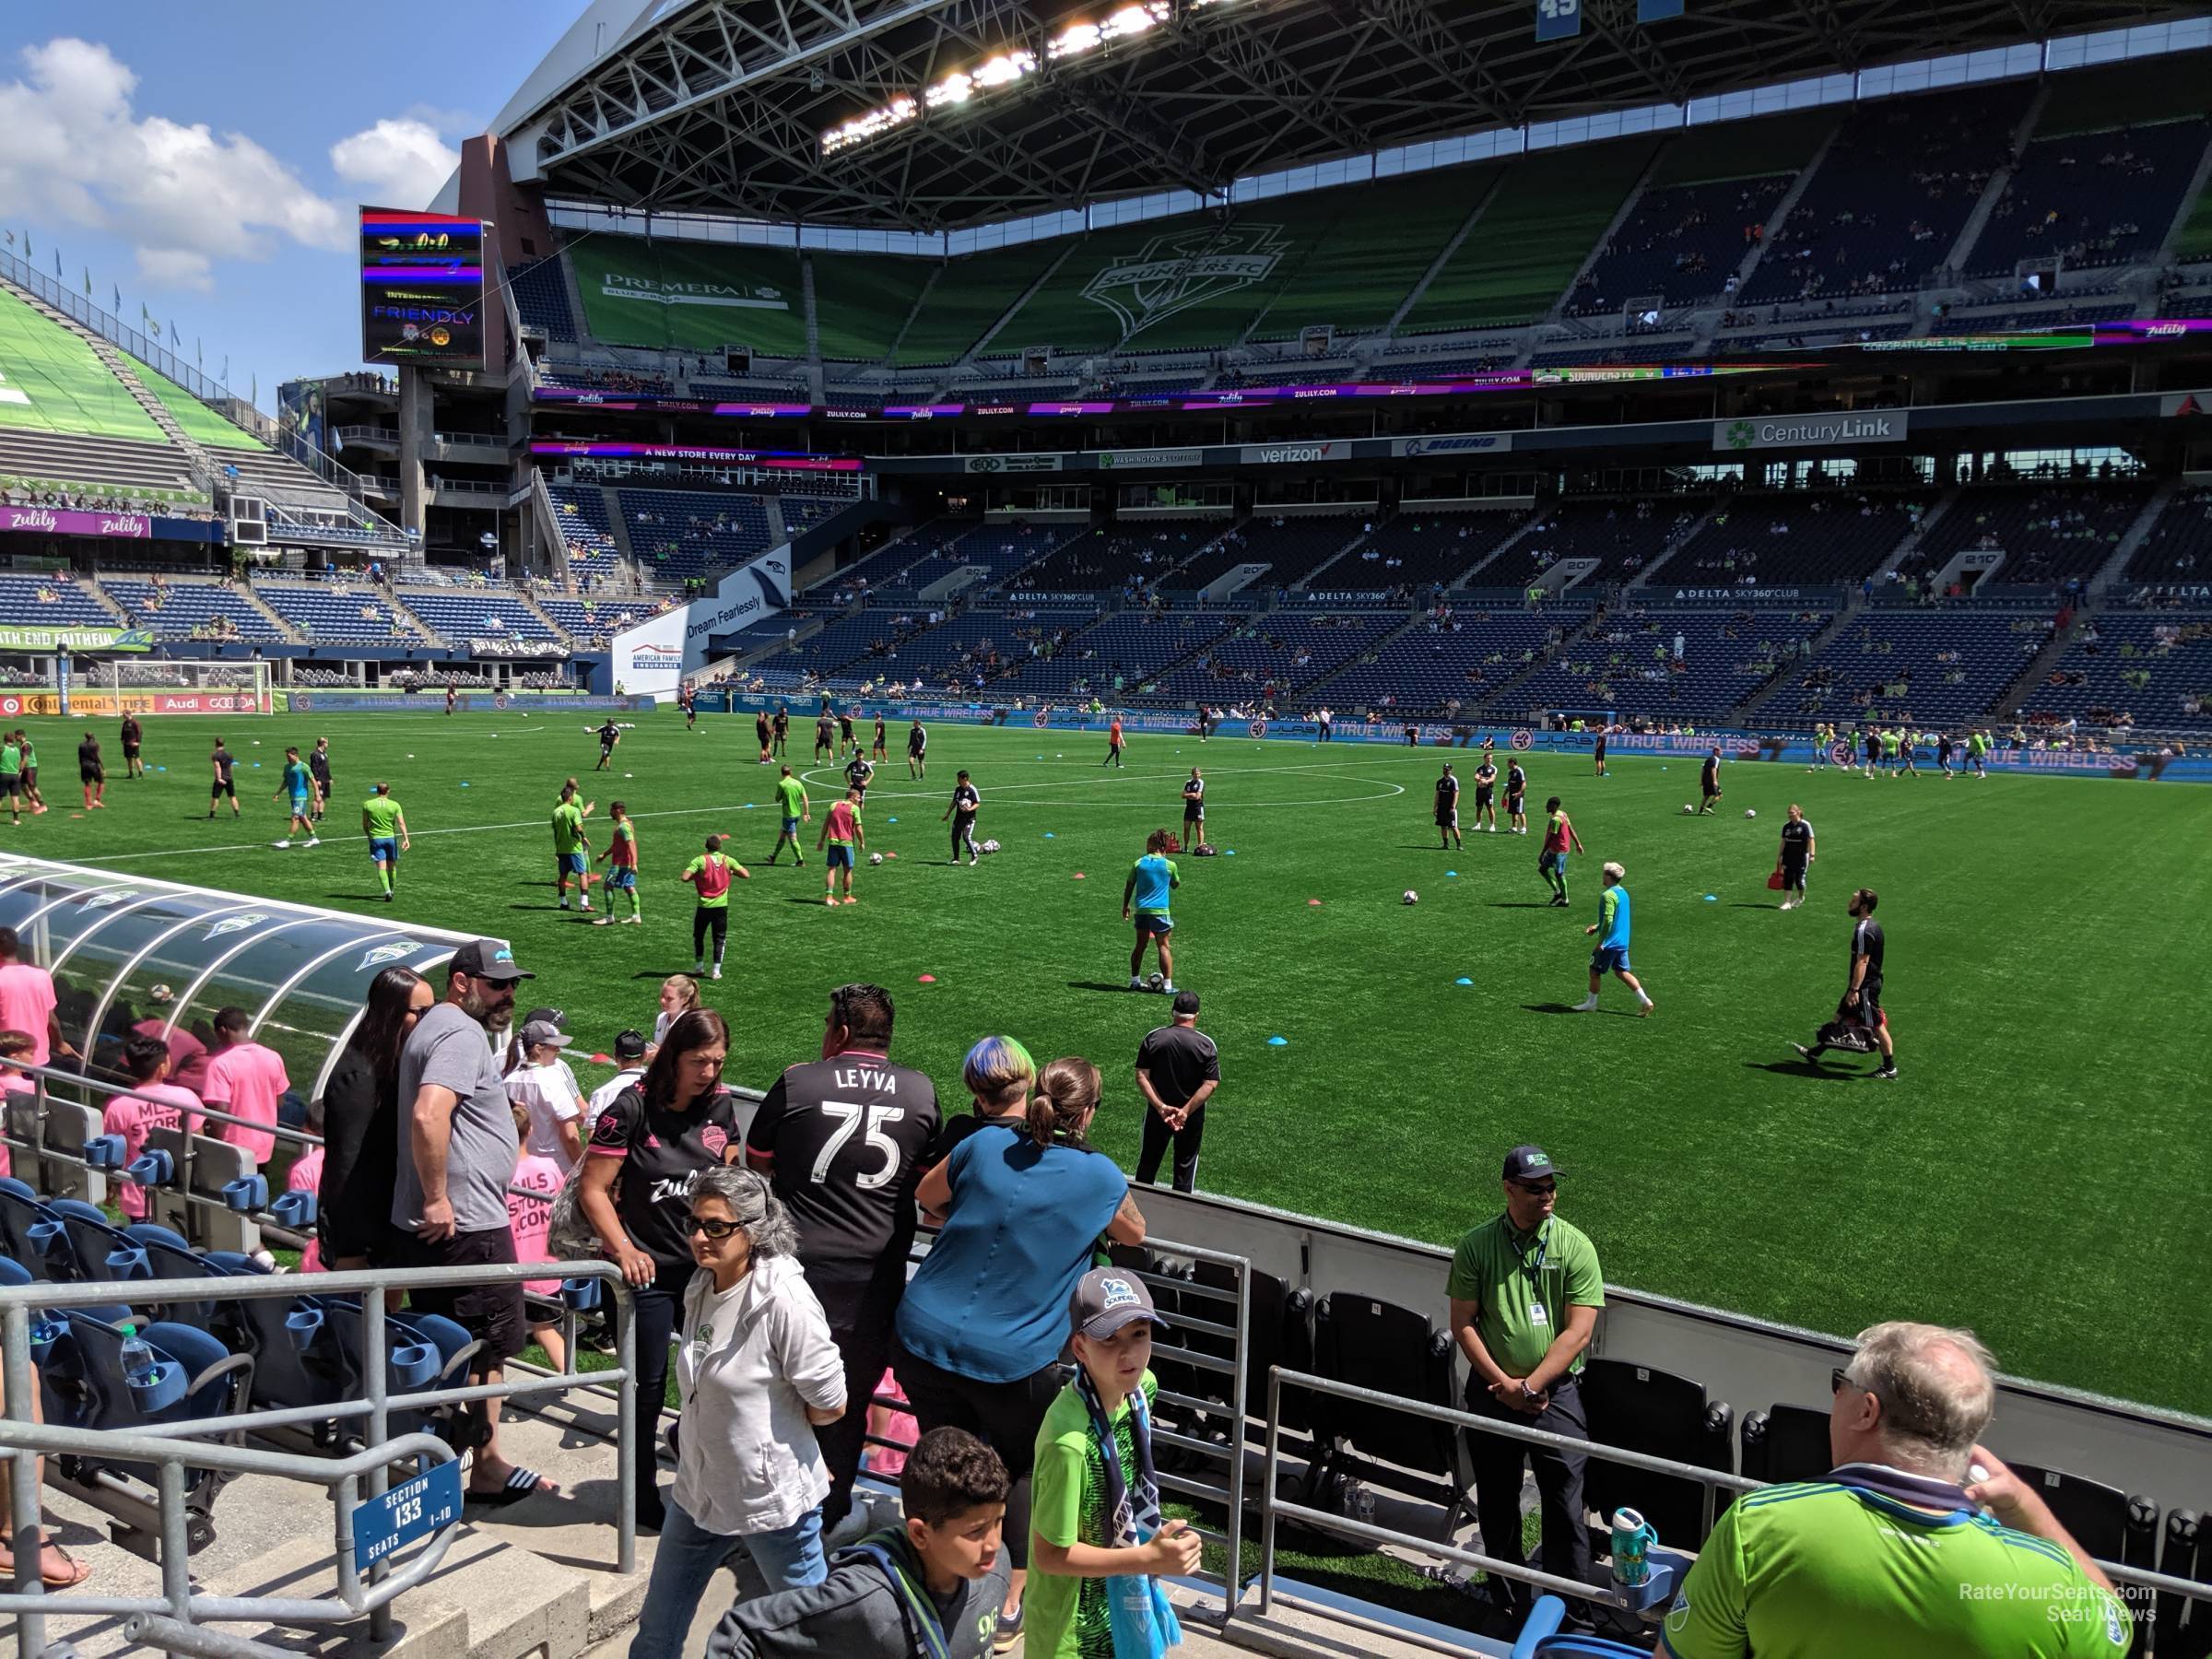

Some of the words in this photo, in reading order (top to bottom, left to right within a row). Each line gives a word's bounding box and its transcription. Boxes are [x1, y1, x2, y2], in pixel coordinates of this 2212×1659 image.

[1101, 263, 1233, 285] SOUNDERS
[1235, 265, 1263, 274] FC
[605, 274, 739, 296] PREMERA
[606, 288, 636, 297] BLUE
[373, 306, 473, 324] FRIENDLY
[1295, 389, 1336, 398] ZULILY.COM
[827, 410, 866, 418] ZULILY.COM
[1761, 418, 1890, 441] CenturyLink
[1427, 437, 1496, 451] BOEING
[645, 449, 653, 457] A
[654, 449, 675, 457] NEW
[677, 451, 706, 459] STORE
[709, 453, 735, 461] EVERY
[738, 453, 756, 462] DAY
[1113, 454, 1167, 464] WASHINGTON'S
[1260, 447, 1323, 463] verizon
[688, 617, 717, 639] Dream
[718, 595, 760, 625] Fearlessly
[25, 632, 51, 645] END
[55, 633, 112, 646] FAITHFUL
[473, 641, 504, 655] DRINK
[504, 641, 531, 655] SING
[28, 696, 105, 713] Contental
[166, 699, 199, 709] Audi
[584, 697, 628, 706] WIRELESS
[914, 707, 940, 717] TRUE
[944, 708, 994, 719] WIRELESS
[1144, 717, 1201, 729] WIRELESS
[1338, 724, 1375, 736] TRUE
[1621, 736, 1665, 749] TRUE
[1673, 736, 1760, 754] WIRELESS
[2029, 751, 2138, 770] WIRELESS
[835, 1069, 896, 1094] LEYVA
[810, 1100, 904, 1189] 75
[513, 1172, 548, 1190] MLS
[385, 1477, 429, 1509] SECTION
[395, 1497, 422, 1528] 133
[430, 1505, 452, 1526] 1-10
[369, 1533, 399, 1559] SEATS
[1619, 1597, 1628, 1607] 13
